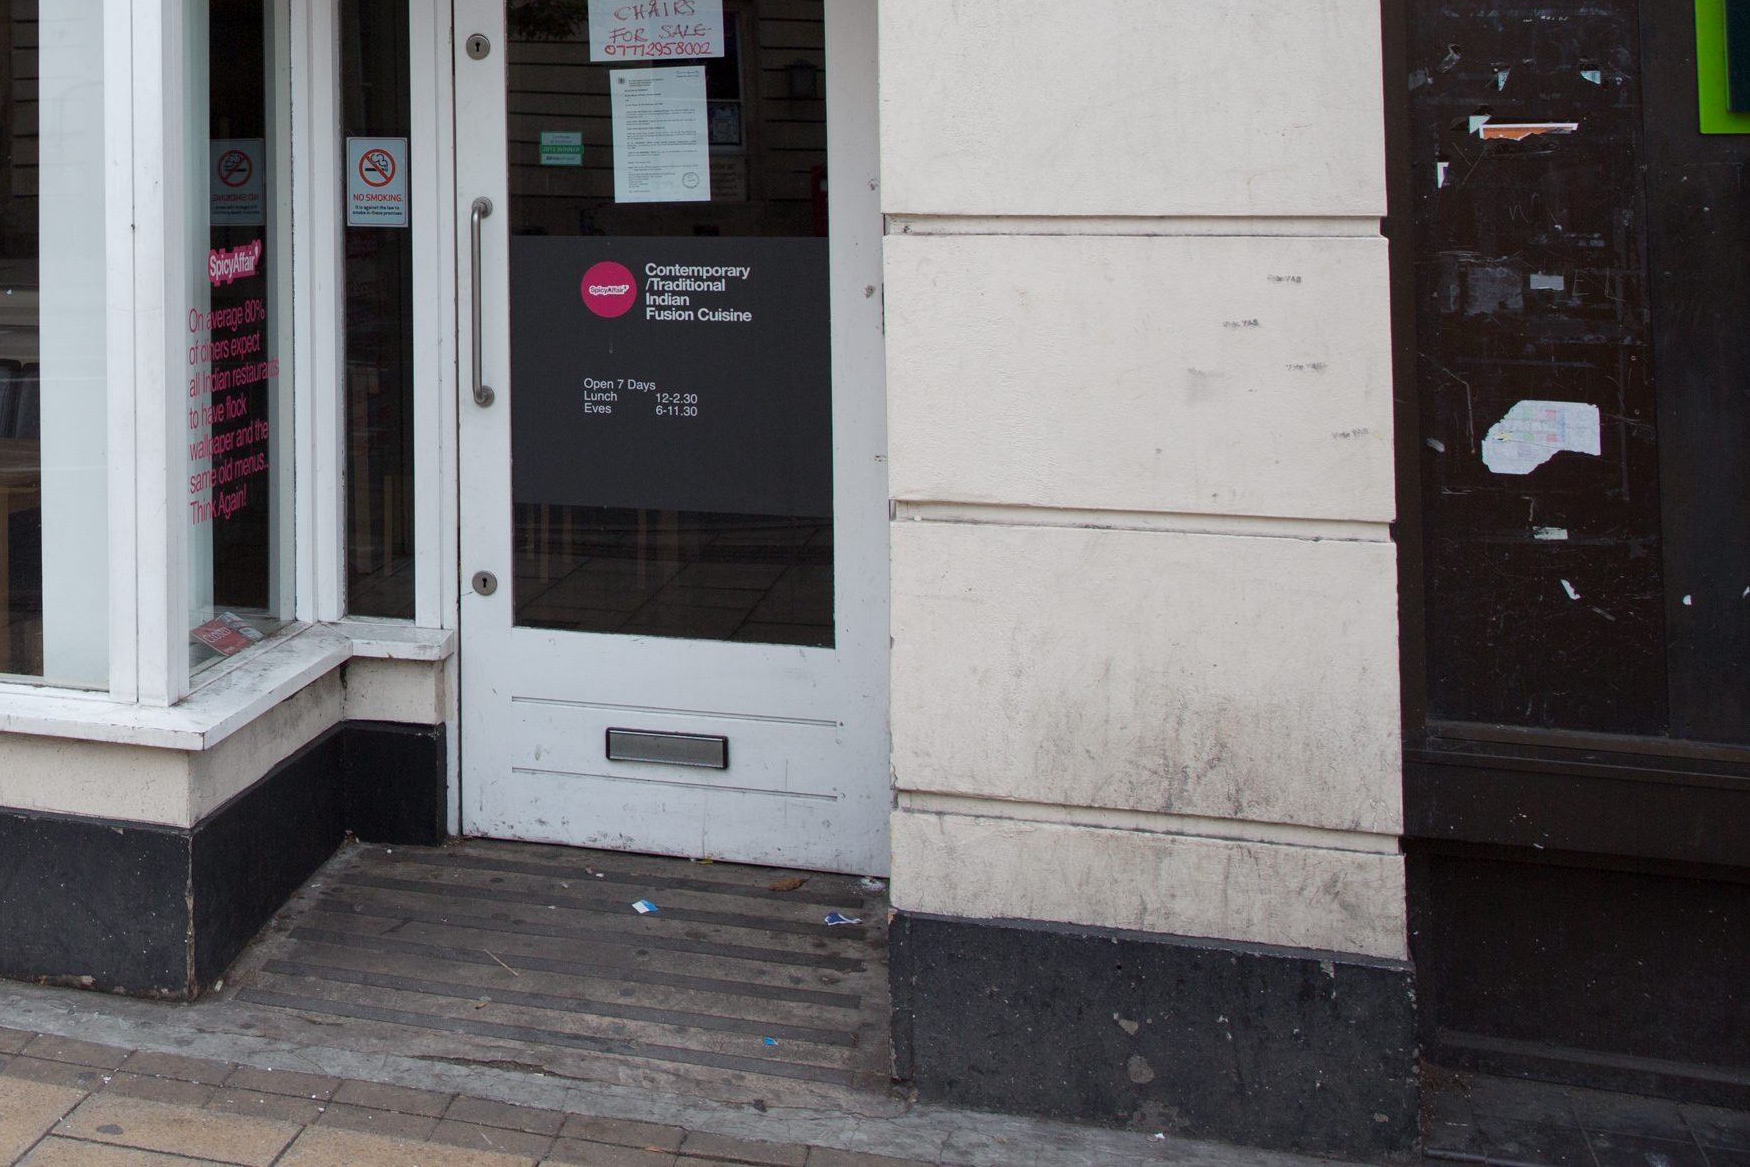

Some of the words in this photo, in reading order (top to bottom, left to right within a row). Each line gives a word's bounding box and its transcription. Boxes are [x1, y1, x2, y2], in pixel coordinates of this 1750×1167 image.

[613, 0, 696, 21] CHAIRS
[610, 27, 648, 44] FOR
[659, 24, 712, 39] SALE
[353, 194, 364, 202] NO
[645, 262, 750, 279] Contemporary
[645, 277, 726, 292] /Traditional
[646, 292, 690, 306] Indian
[189, 308, 204, 333] On
[206, 306, 243, 332] average
[244, 299, 266, 323] 80%
[646, 307, 694, 321] Fusion
[697, 308, 752, 322] Cuisine
[189, 339, 199, 366] of
[201, 338, 229, 363] diners
[230, 330, 261, 360] expect
[190, 372, 201, 398] all
[203, 366, 231, 394] Indian
[232, 358, 279, 387] restaurants
[583, 377, 614, 391] Open
[617, 379, 624, 390] 7
[627, 379, 656, 391] Days
[583, 390, 618, 402] Lunch
[655, 392, 698, 404] 12-2.30
[190, 407, 199, 430] to
[202, 402, 224, 426] have
[226, 392, 248, 419] flock
[584, 402, 612, 414] Eves
[655, 404, 698, 417] 6-11.30
[190, 431, 235, 462] wallpaper
[236, 421, 252, 447] and
[255, 418, 268, 441] the
[190, 467, 216, 494] same
[218, 457, 233, 484] old
[190, 496, 216, 525] Think
[218, 483, 247, 520] Again!
